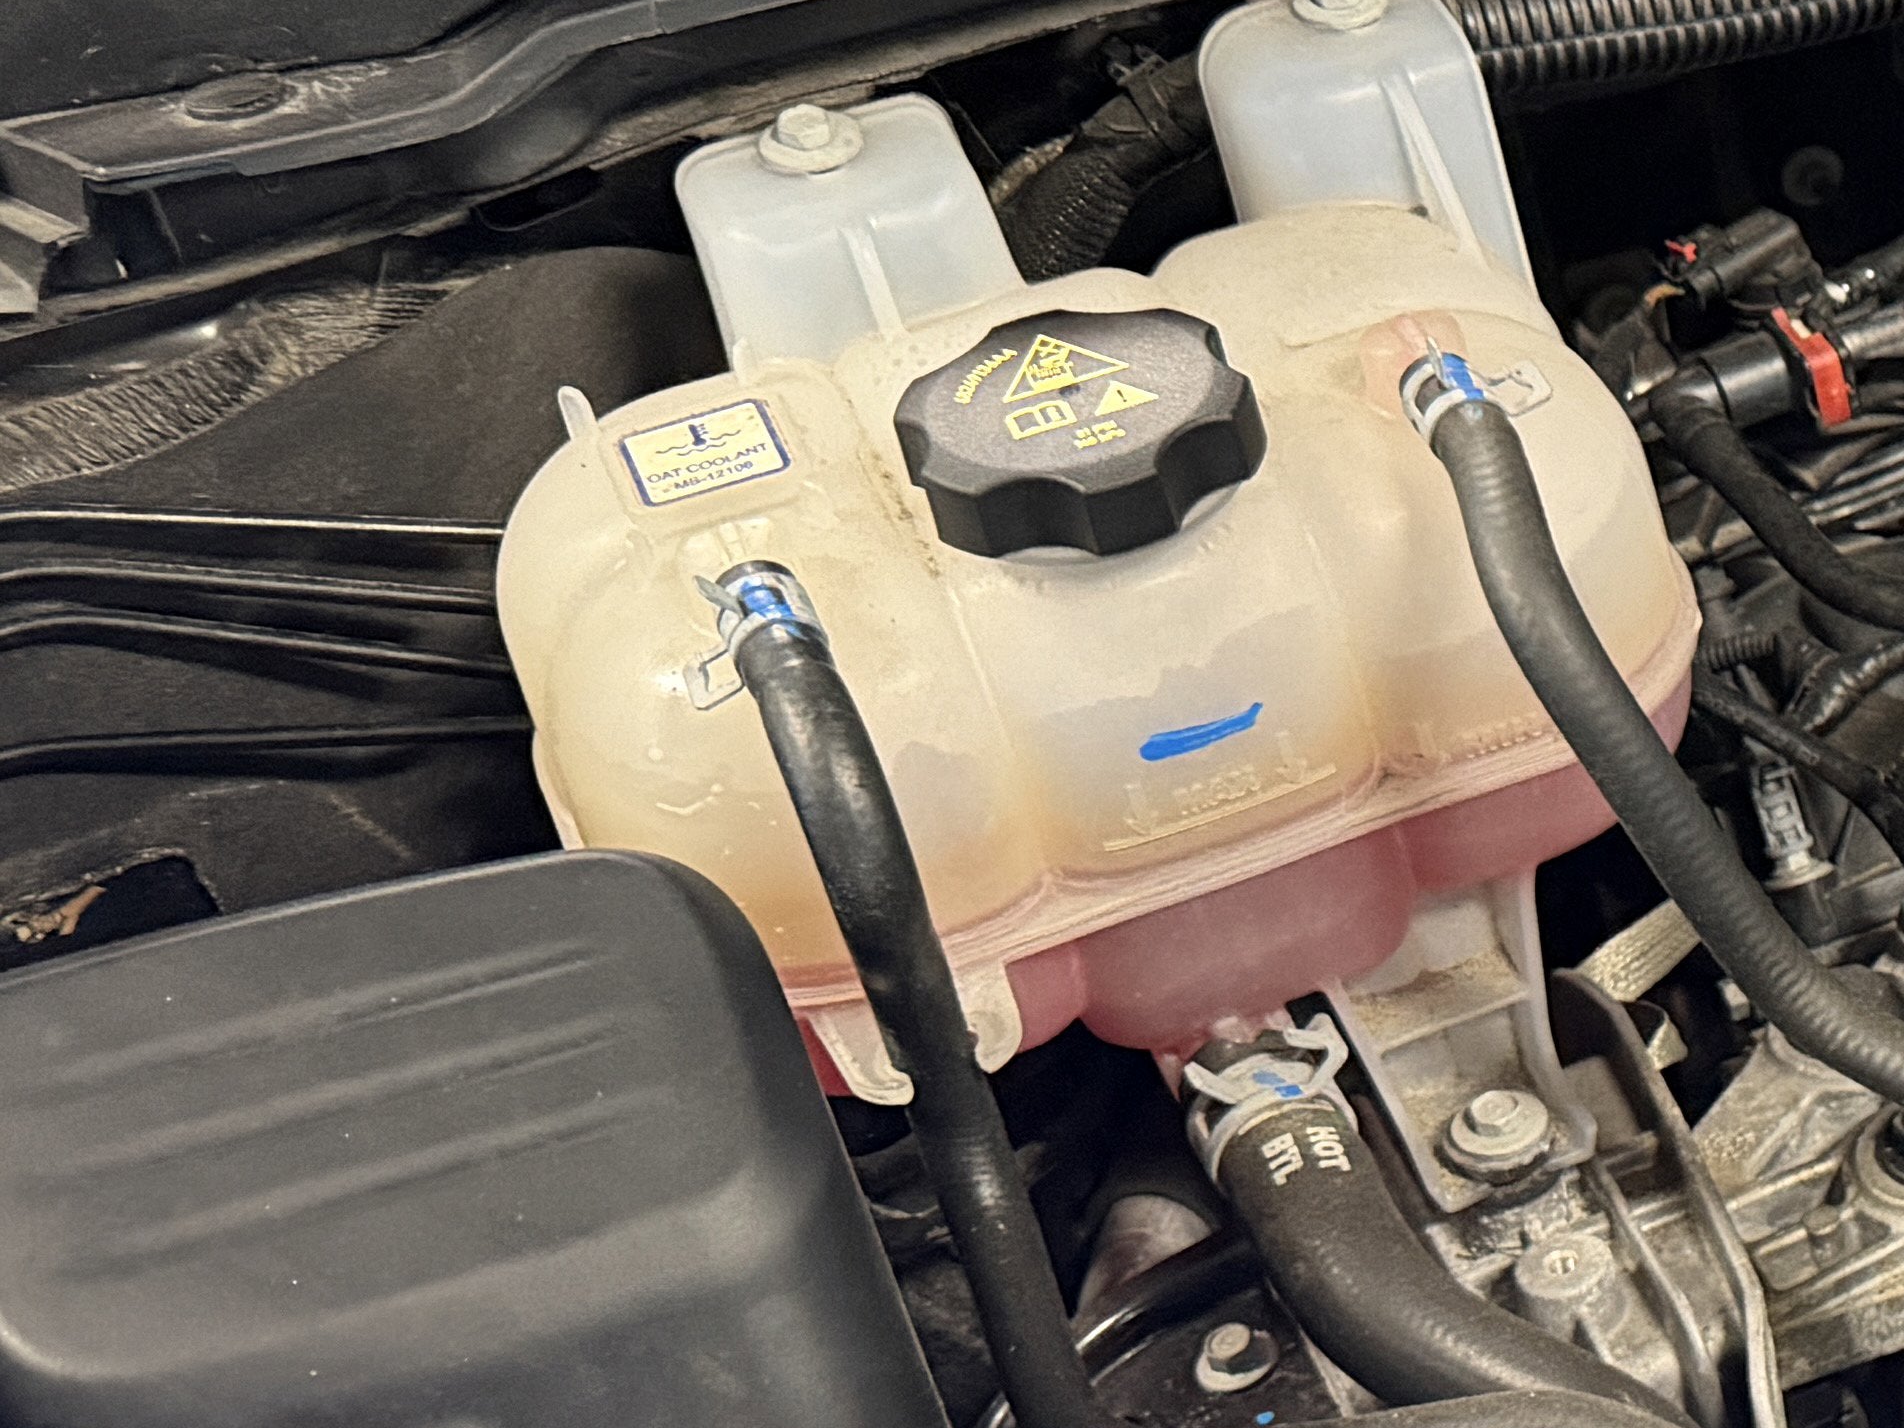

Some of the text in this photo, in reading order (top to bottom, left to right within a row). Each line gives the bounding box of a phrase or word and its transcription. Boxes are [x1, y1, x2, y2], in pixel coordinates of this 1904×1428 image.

[646, 442, 767, 483] OAT COOLANT
[1261, 1132, 1304, 1186] BTL
[1305, 1126, 1351, 1171] HOT
